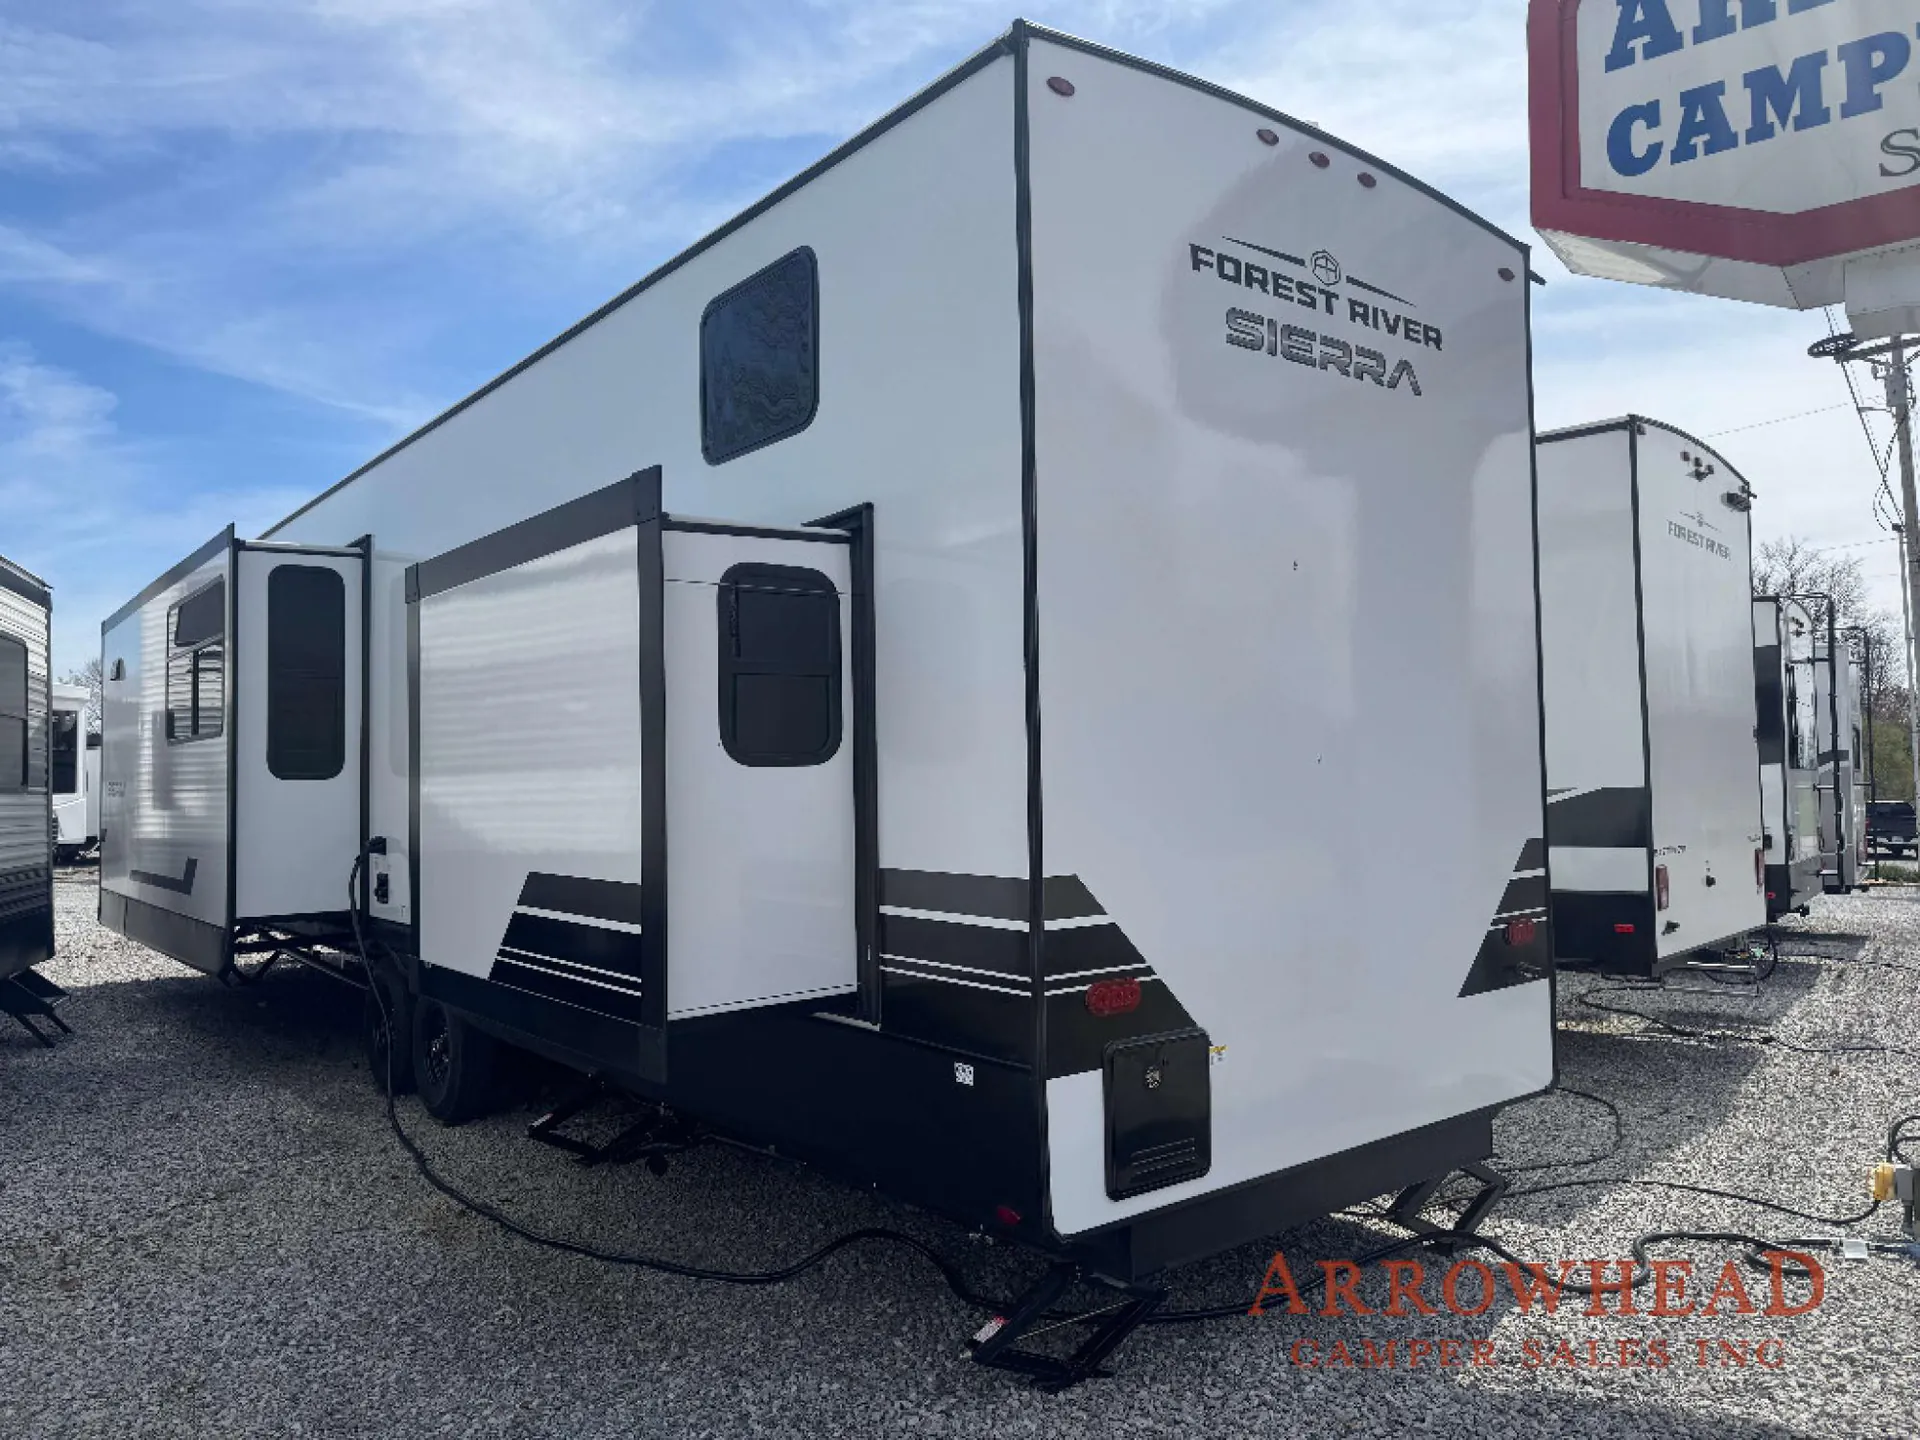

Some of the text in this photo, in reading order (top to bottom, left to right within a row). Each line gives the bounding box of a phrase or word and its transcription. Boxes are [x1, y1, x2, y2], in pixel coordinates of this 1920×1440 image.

[1606, 22, 1920, 177] CAMP
[1189, 243, 1443, 351] FOREST RIVER
[1226, 307, 1422, 396] SIERRA
[1667, 519, 1705, 549] FOREST
